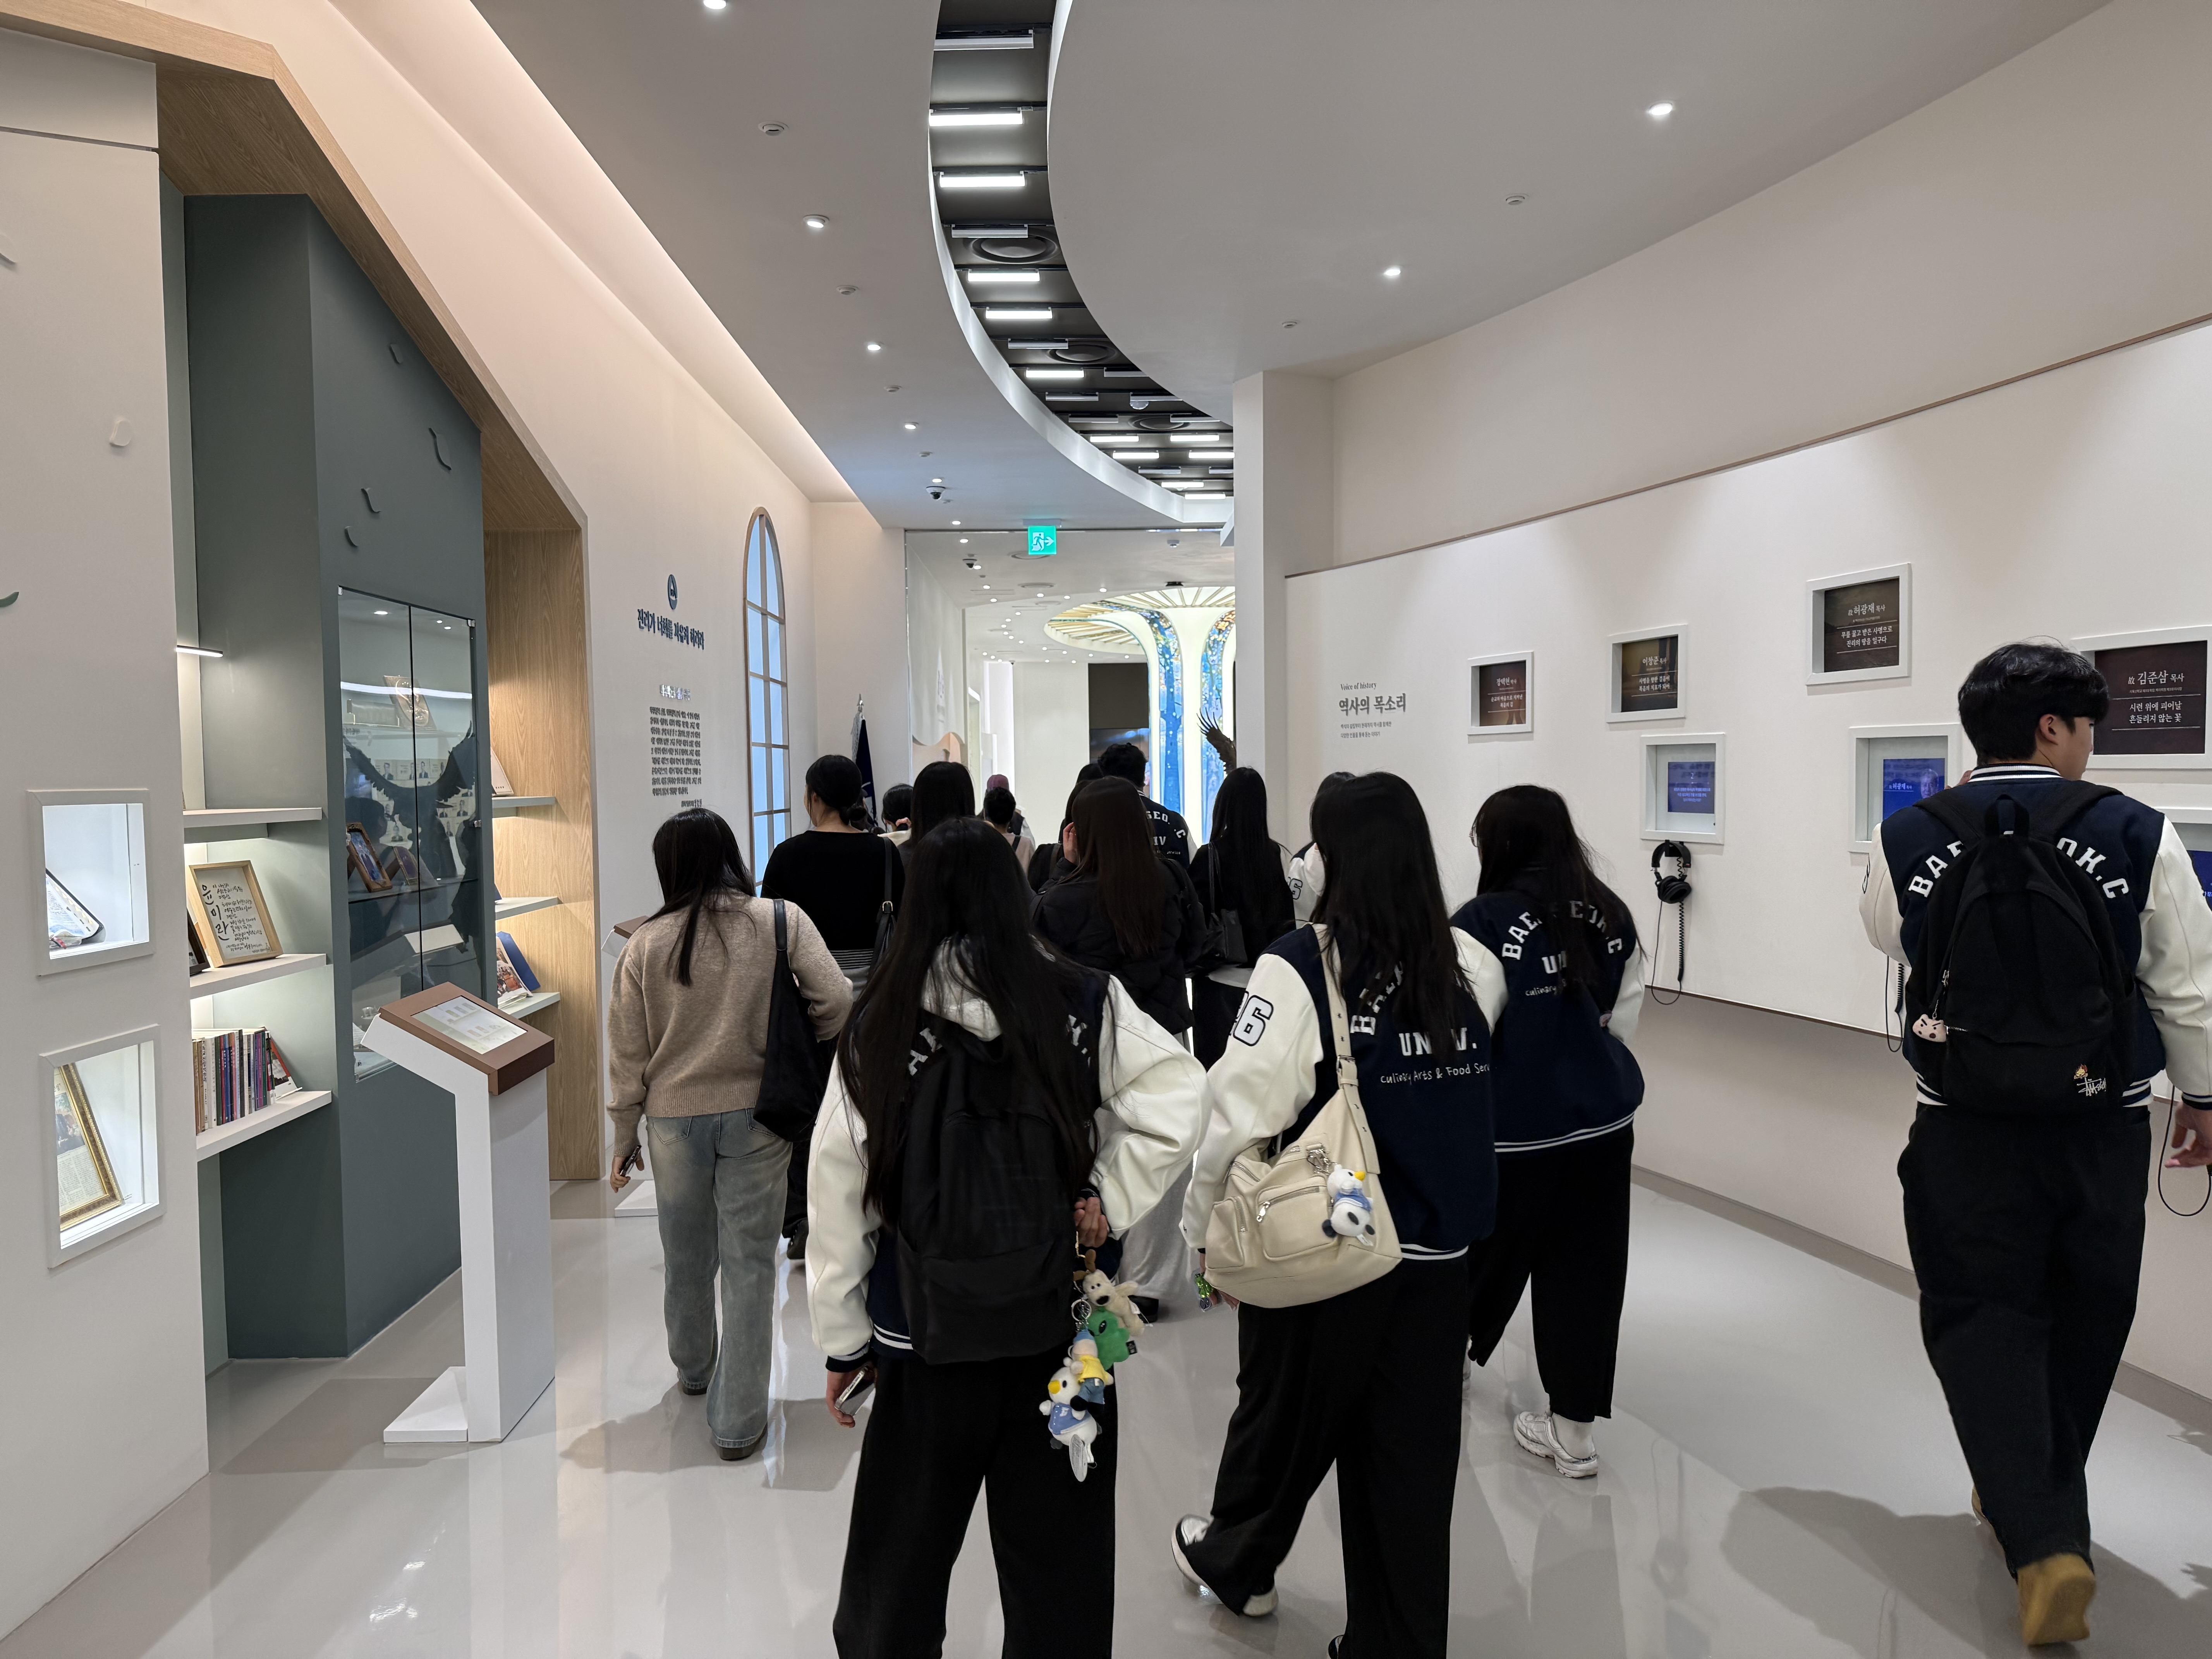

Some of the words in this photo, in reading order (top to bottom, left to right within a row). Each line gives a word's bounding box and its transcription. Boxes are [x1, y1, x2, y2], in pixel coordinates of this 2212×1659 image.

[1853, 603, 1874, 615] 허광재
[1876, 604, 1885, 612] 목사
[637, 609, 655, 634] 진리가
[657, 616, 673, 639] 너희를
[674, 622, 689, 645] 자유케
[690, 628, 704, 650] 하리라
[1873, 626, 1893, 634] 사명으로
[1846, 639, 1860, 647] 진리의
[1872, 635, 1887, 644] 일구다
[1643, 656, 1659, 666] 이창준
[2128, 676, 2135, 685] 故
[2138, 670, 2169, 685] 김준삼
[2170, 673, 2184, 683] 목사
[1339, 696, 1370, 716] 역사의
[1374, 693, 1406, 714] 목소리
[2130, 702, 2143, 712] 시련
[2145, 702, 2159, 711] 위에
[2161, 701, 2182, 711] 피어날
[2130, 714, 2156, 723] 흔들리지
[2158, 713, 2172, 722] 않는
[2174, 713, 2182, 722] 꽃
[1229, 991, 1274, 1046] 6
[1399, 1027, 1477, 1056] UNV.
[1413, 1070, 1432, 1082] Arts
[1436, 1068, 1443, 1079] &
[1446, 1064, 1471, 1076] Food
